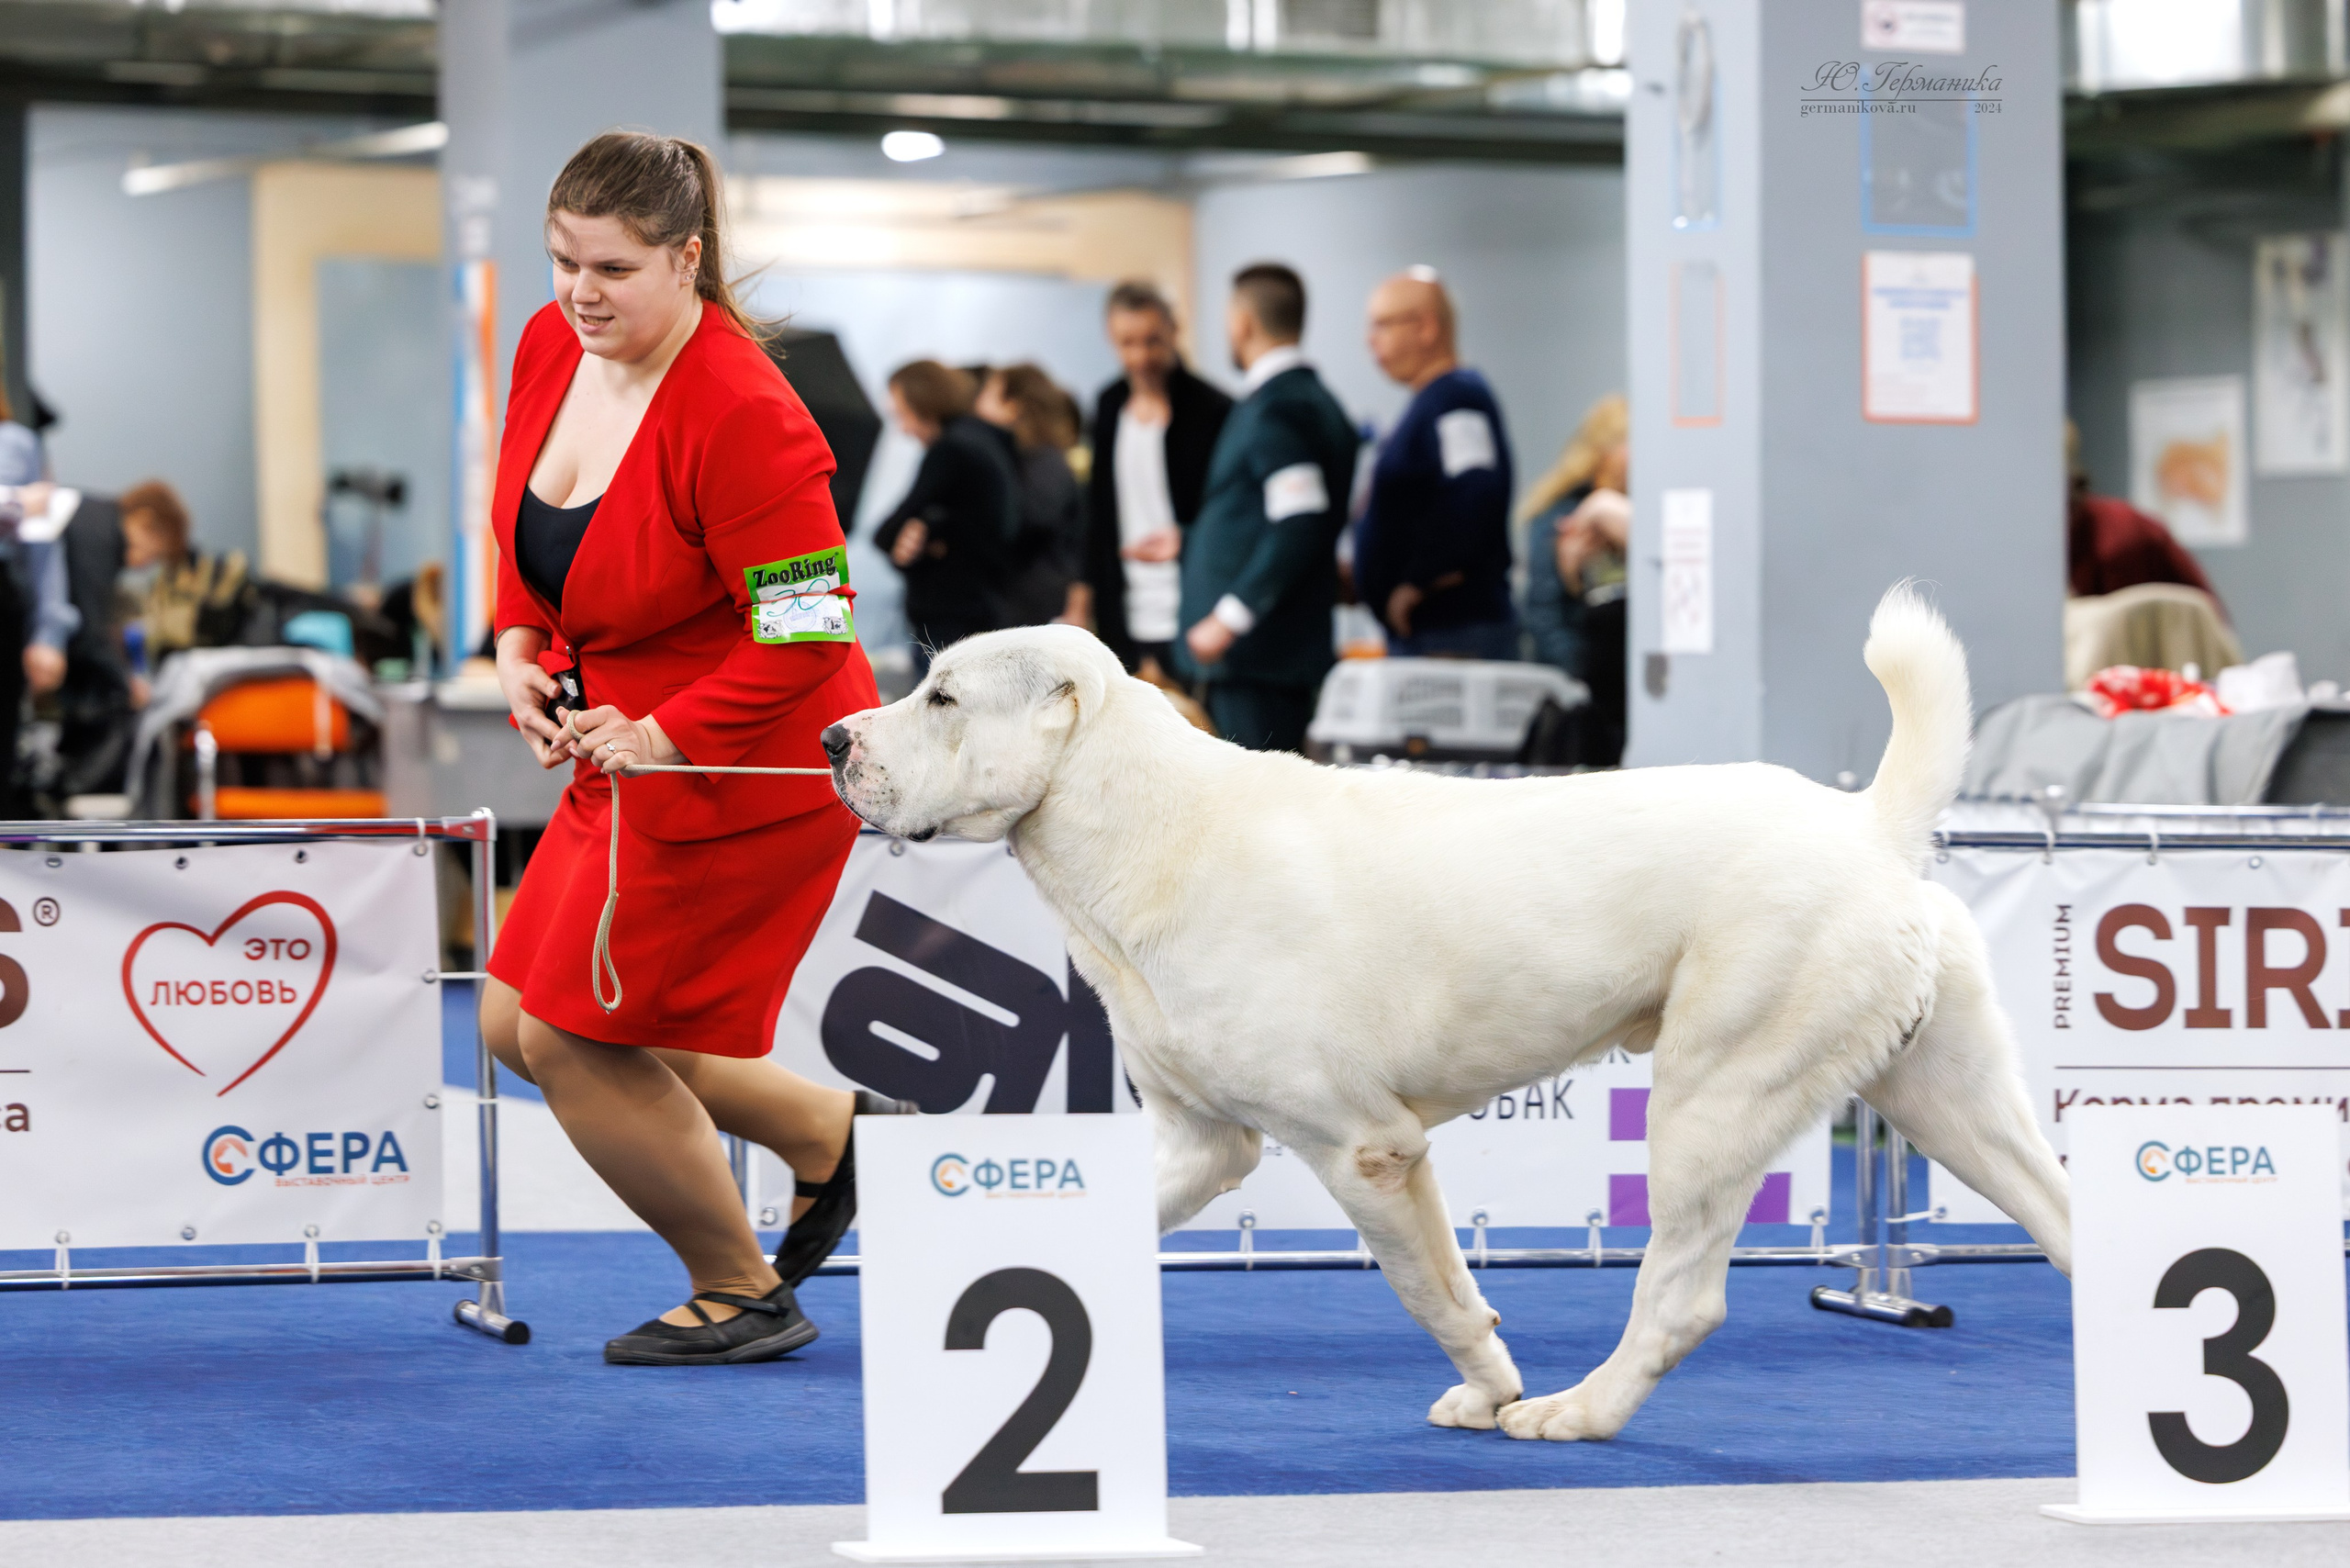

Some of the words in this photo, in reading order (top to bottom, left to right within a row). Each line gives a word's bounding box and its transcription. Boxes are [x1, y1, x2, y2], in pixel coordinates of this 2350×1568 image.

[753, 555, 837, 587] ZooRing
[243, 937, 312, 961] ЭТО
[2053, 904, 2072, 1029] PREMIUM
[2093, 902, 2350, 1031] SIR
[150, 980, 297, 1006] ЛЮБОВЬ
[202, 1125, 409, 1186] СФЕРА
[931, 1153, 1085, 1197] СФЕРА
[2135, 1140, 2277, 1182] СФЕРА
[941, 1267, 1100, 1515] 2
[2147, 1248, 2290, 1484] 3
